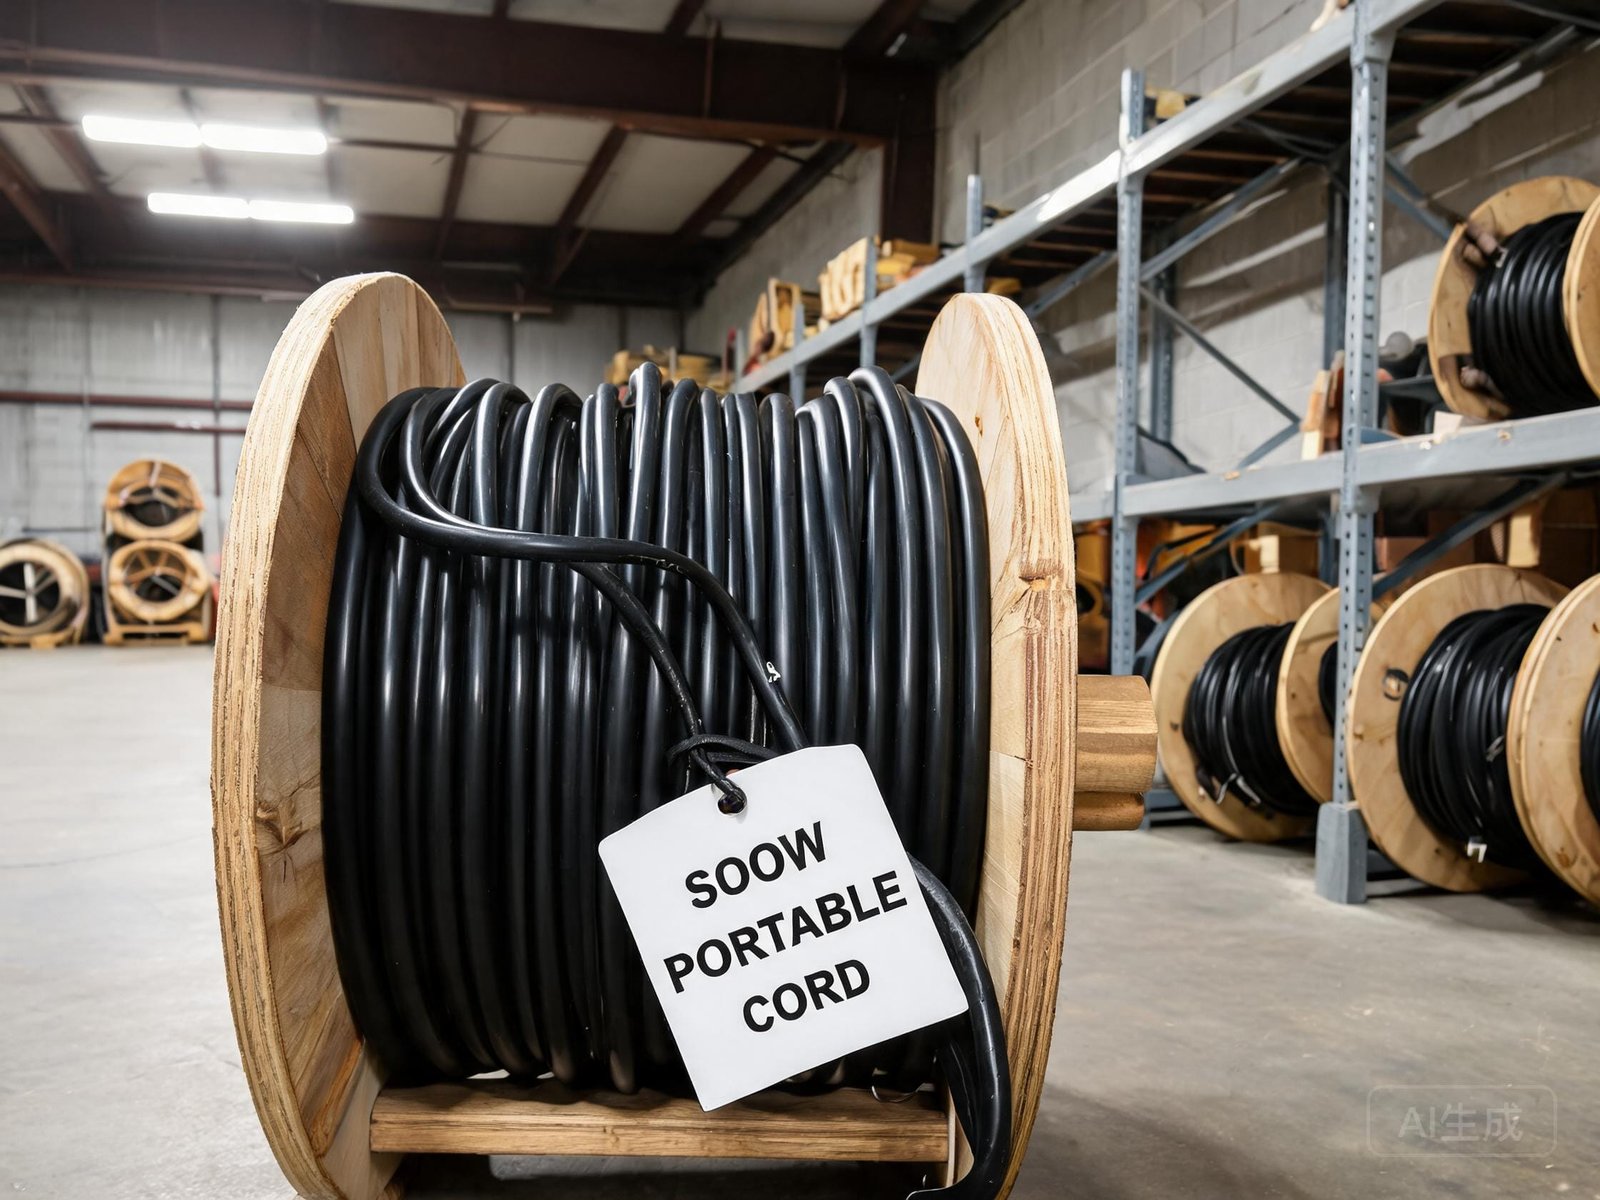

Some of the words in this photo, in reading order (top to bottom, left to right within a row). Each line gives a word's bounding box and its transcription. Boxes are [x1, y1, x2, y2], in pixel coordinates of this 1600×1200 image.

[685, 820, 827, 909] SOOW
[663, 870, 908, 994] PORTABLE
[742, 959, 870, 1033] CORD
